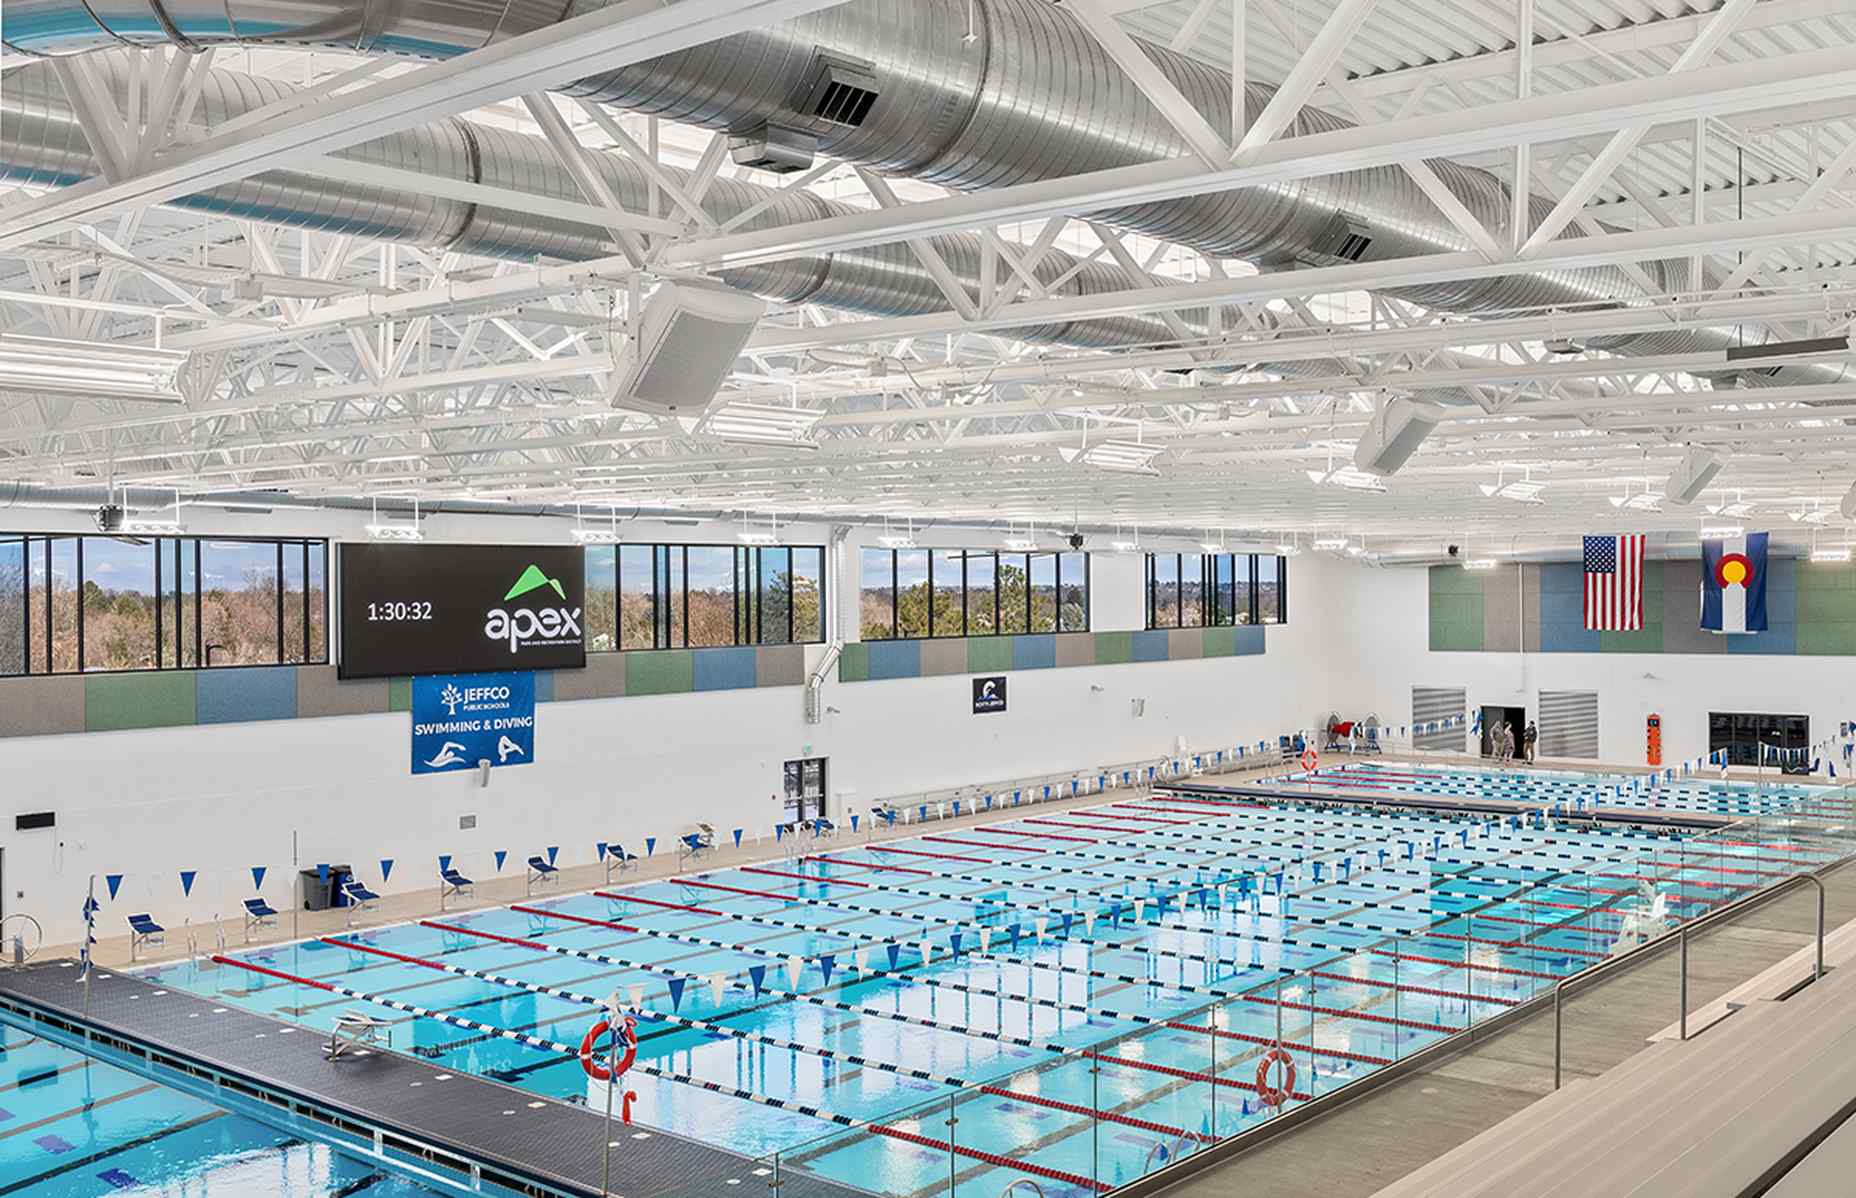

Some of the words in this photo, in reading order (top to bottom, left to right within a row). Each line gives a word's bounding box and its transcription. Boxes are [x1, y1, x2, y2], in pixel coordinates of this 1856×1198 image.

[367, 601, 433, 621] 1:30:32
[484, 607, 582, 654] apex
[463, 686, 510, 704] JEFFCO
[415, 720, 481, 736] SWIMMING
[483, 719, 492, 731] &
[494, 716, 533, 730] DIVING
